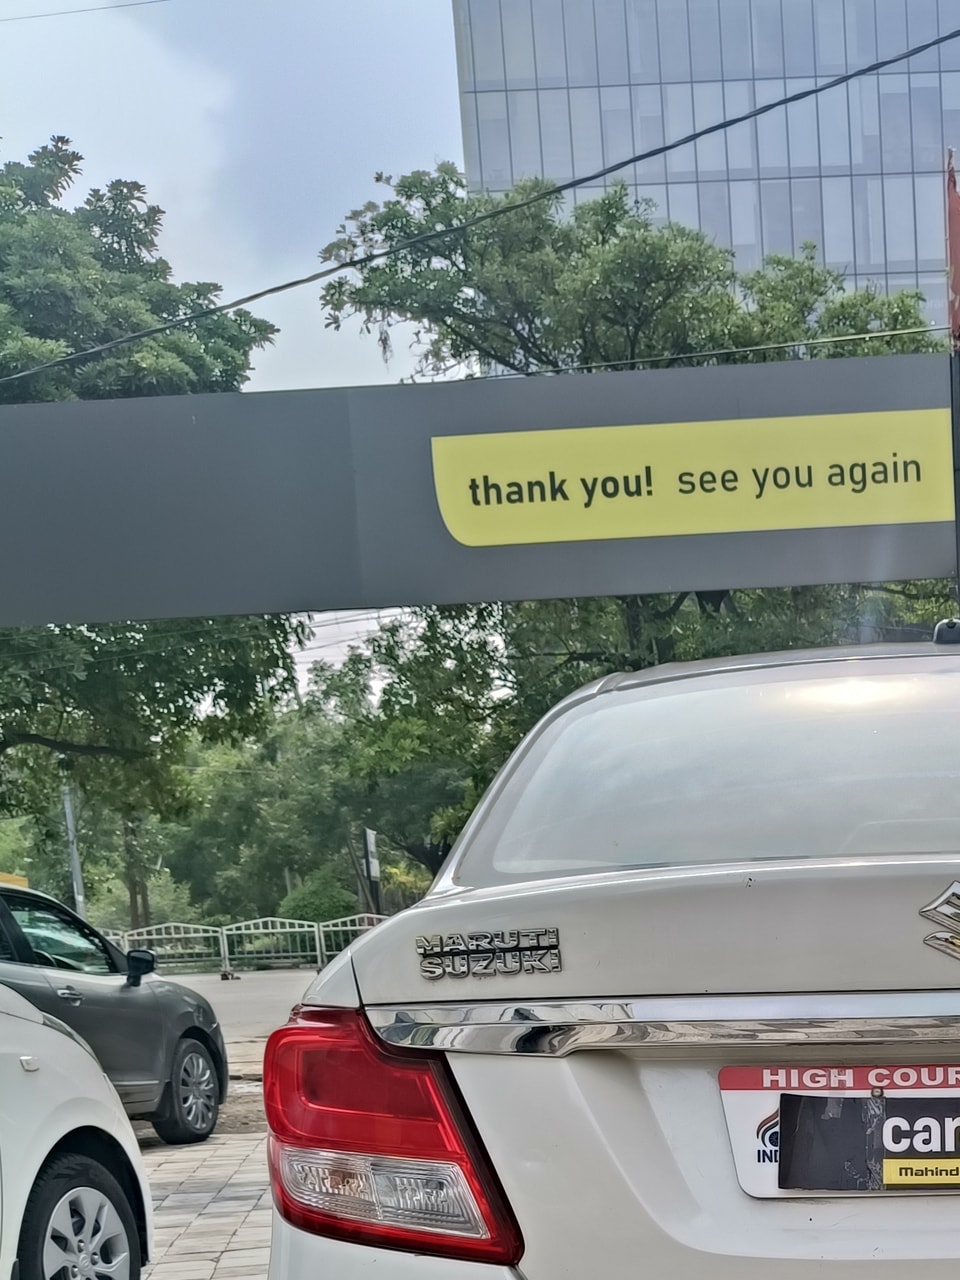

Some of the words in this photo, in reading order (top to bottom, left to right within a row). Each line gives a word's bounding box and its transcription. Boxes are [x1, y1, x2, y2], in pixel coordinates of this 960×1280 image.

[468, 471, 570, 506] thank
[579, 465, 653, 509] you!
[677, 469, 738, 495] see
[751, 464, 813, 500] you
[827, 452, 921, 494] again
[416, 927, 559, 955] MARUTI
[420, 949, 563, 981] SUZUKI
[762, 1068, 854, 1088] HIGH
